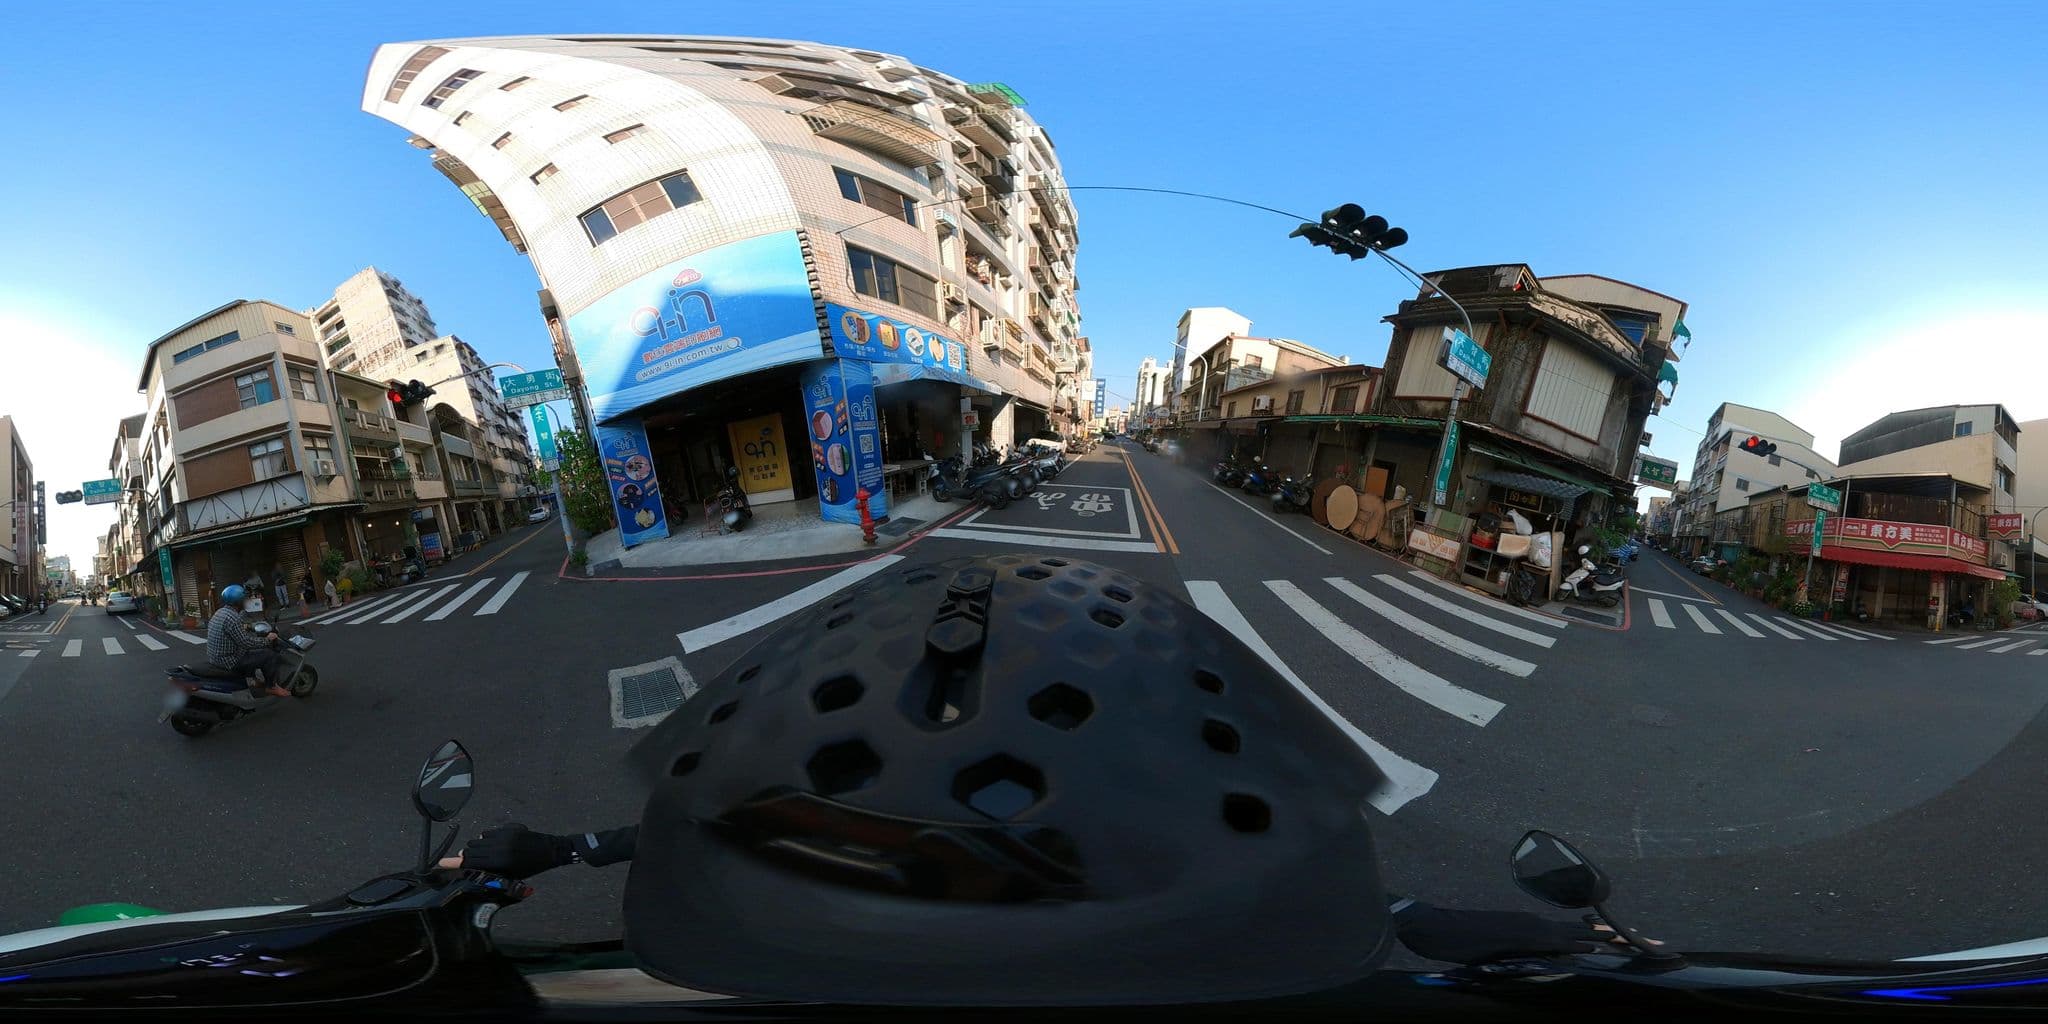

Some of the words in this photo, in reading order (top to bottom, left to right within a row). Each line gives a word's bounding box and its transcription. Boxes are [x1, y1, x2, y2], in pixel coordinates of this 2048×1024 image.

[505, 371, 555, 387] 大勇街
[511, 384, 540, 394] Dayong
[1871, 524, 1912, 540] 東方美
[1953, 533, 1973, 551] 東方美
